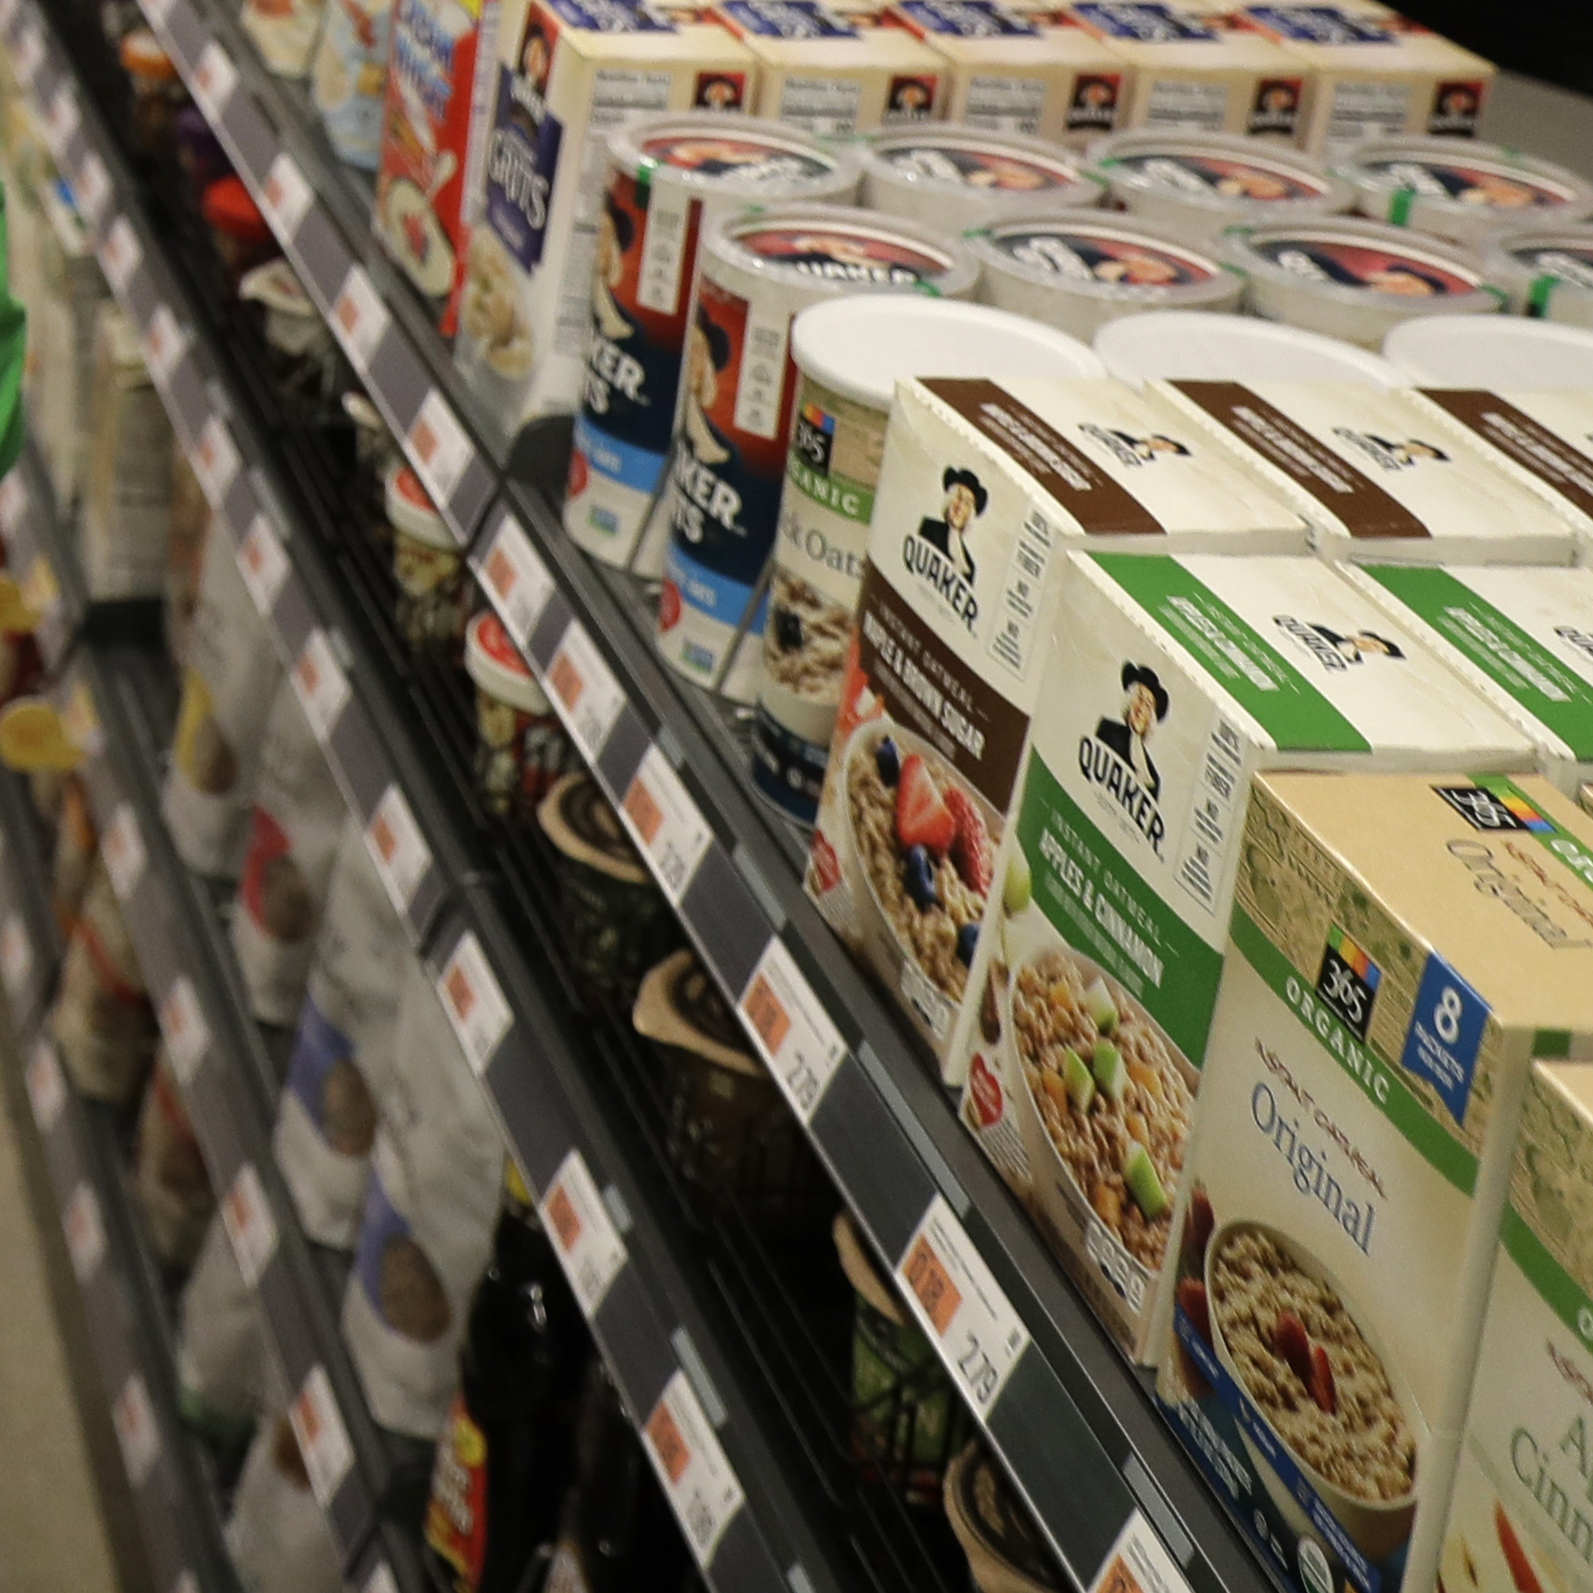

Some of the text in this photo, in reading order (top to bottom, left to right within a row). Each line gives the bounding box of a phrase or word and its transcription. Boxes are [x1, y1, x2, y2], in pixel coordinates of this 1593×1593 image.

[902, 534, 979, 633] QUAKER
[1077, 736, 1165, 856] QUAKER
[1285, 975, 1391, 1106] ORGANIC
[1323, 958, 1369, 1024] 365
[1433, 985, 1463, 1045] 8
[1251, 1081, 1376, 1257] Original
[956, 1328, 999, 1405] 2.79
